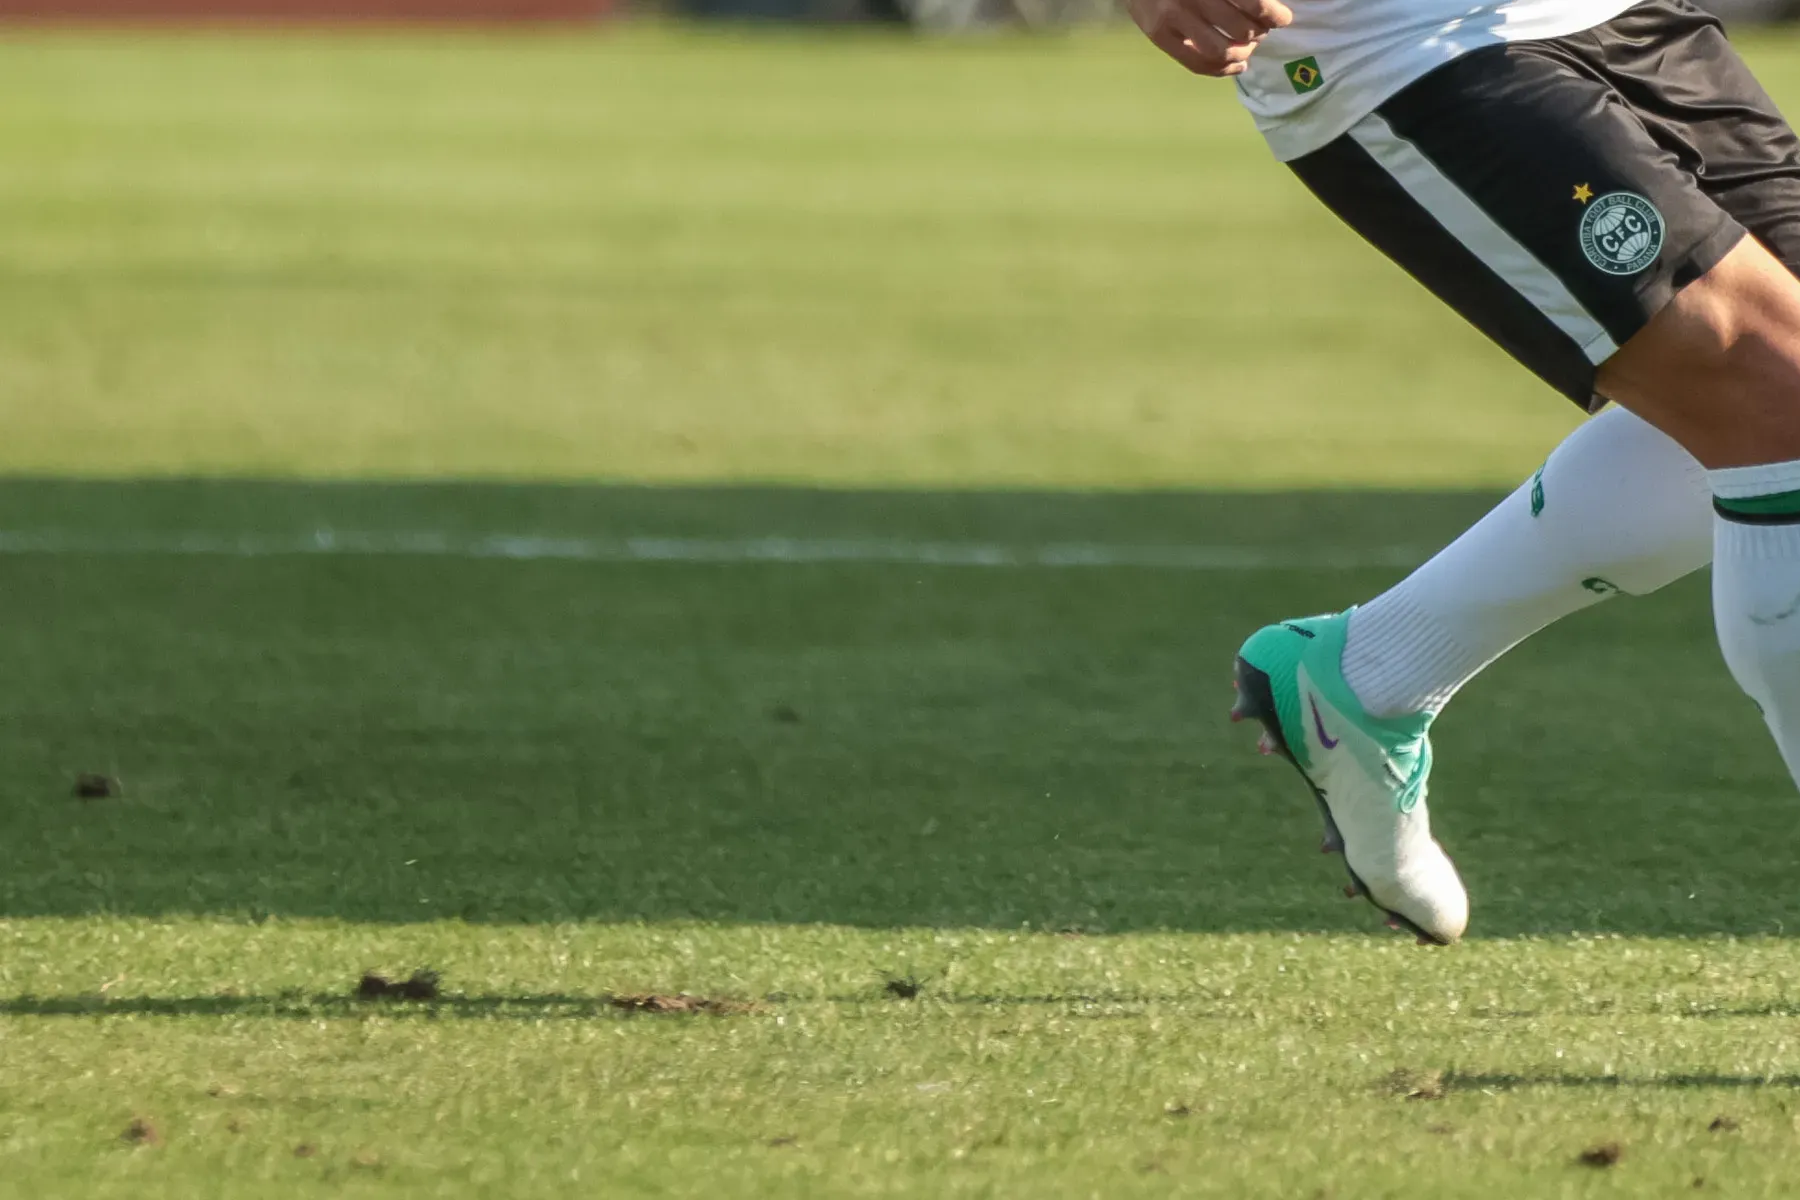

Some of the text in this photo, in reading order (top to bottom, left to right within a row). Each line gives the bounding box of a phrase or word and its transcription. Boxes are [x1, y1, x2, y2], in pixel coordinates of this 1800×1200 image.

[1583, 195, 1657, 268] CORITIBA FOOT BALL CLUB
[1602, 214, 1642, 253] CFC
